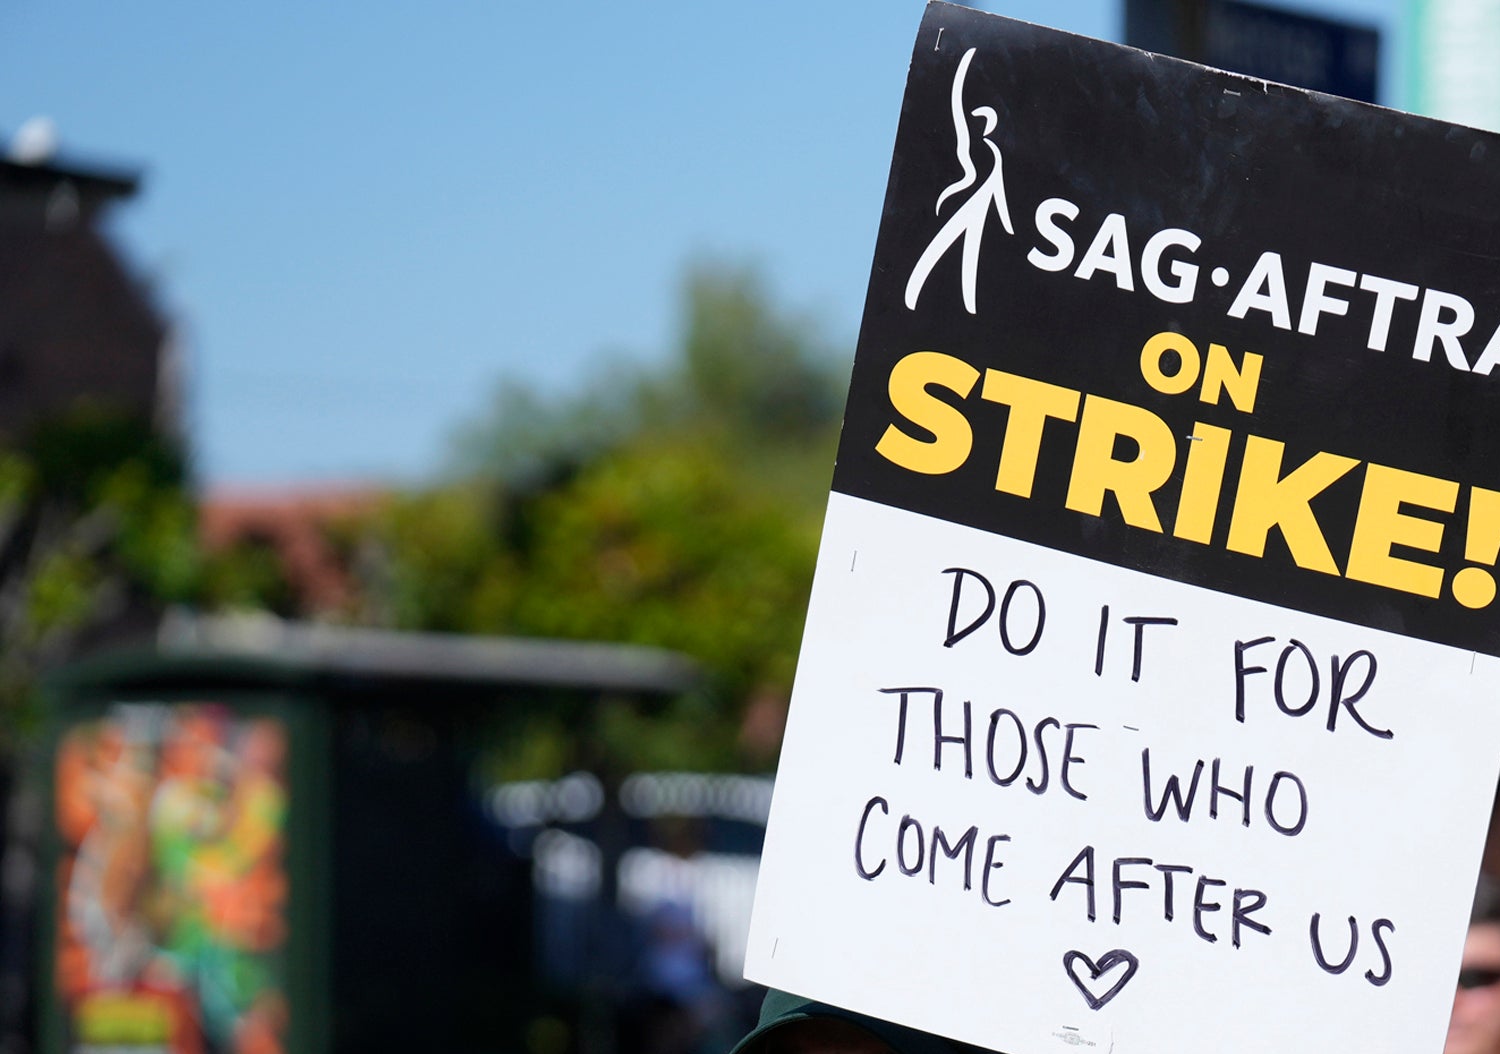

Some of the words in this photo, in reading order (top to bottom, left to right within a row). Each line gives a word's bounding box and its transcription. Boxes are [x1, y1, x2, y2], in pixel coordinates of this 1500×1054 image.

[1139, 331, 1264, 414] ON
[941, 567, 1047, 657] DO
[1094, 604, 1179, 683] IT
[1234, 636, 1394, 740] FOR
[877, 687, 1100, 801] THOSE
[1141, 747, 1310, 837] WHO
[854, 795, 1012, 907] COME
[1049, 845, 1273, 950] AFTER
[1309, 912, 1395, 987] US
